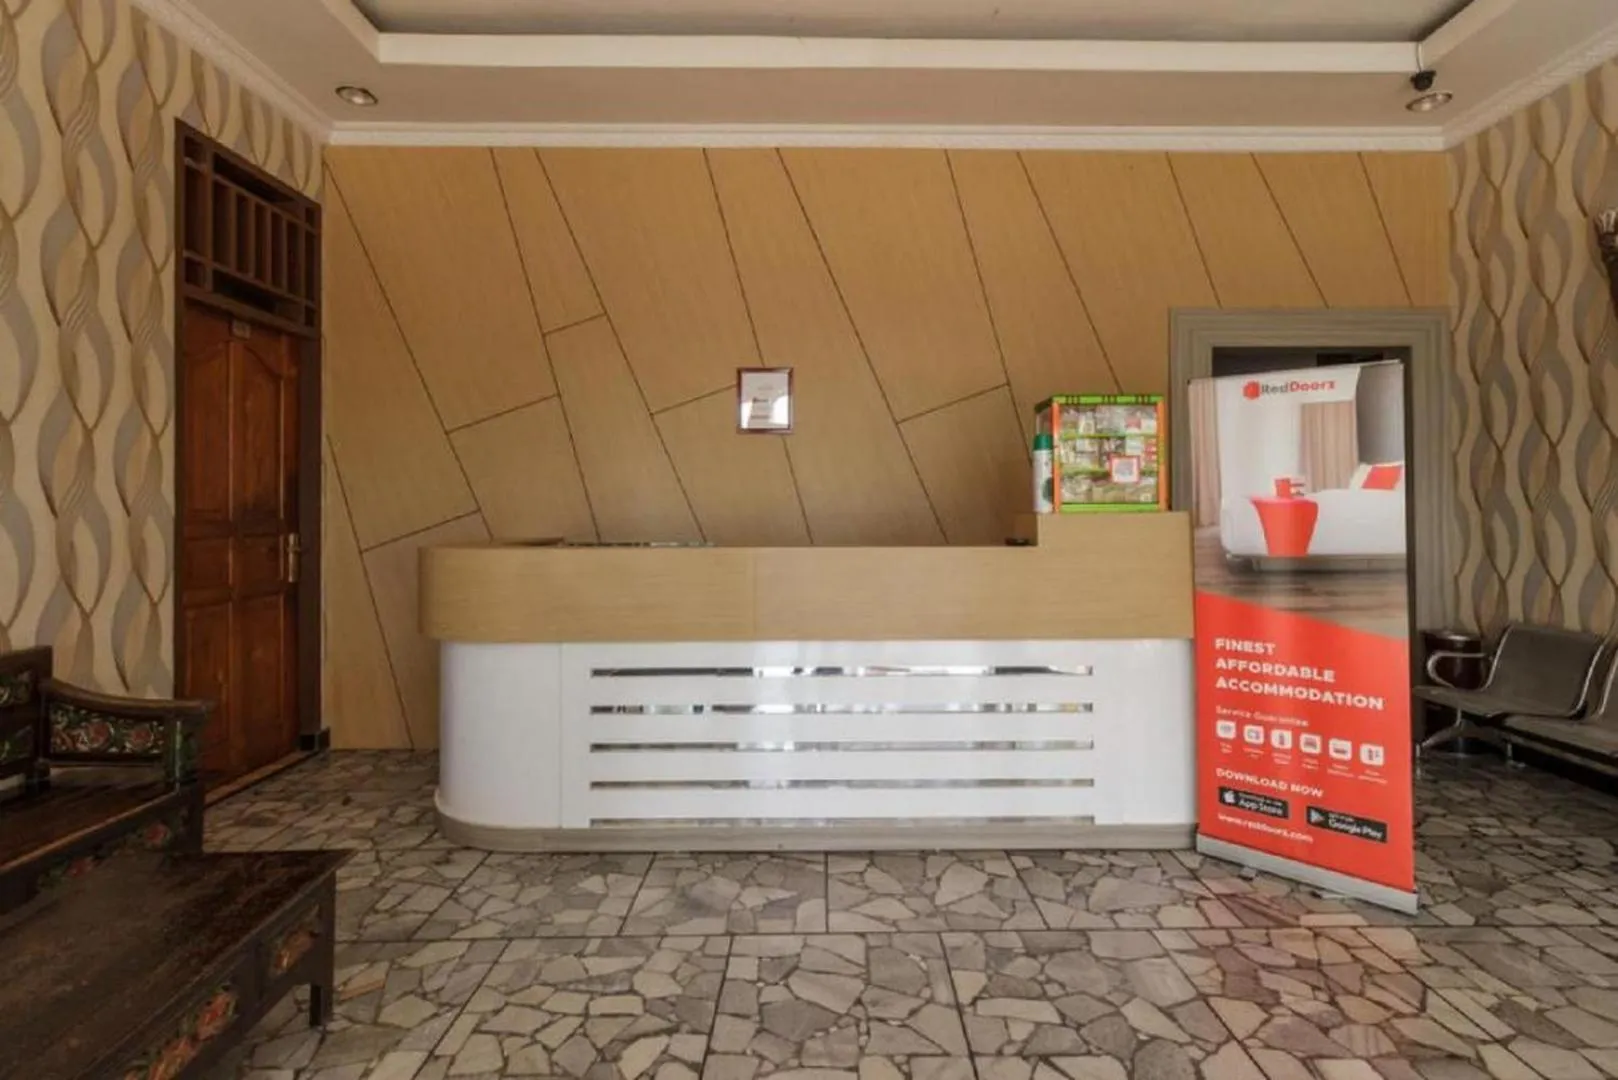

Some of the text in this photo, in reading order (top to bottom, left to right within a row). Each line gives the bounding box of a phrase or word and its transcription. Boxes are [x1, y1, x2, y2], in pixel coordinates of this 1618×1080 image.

[1214, 637, 1276, 655] FINEST
[1215, 657, 1336, 683] AFFORDABLE
[1215, 676, 1384, 710] ACCOMMODATION
[1215, 705, 1252, 718] Service
[1215, 767, 1325, 797] DOWNLOAD NOW
[1238, 799, 1258, 810] App
[1259, 803, 1284, 815] Store
[1328, 819, 1384, 840] Google Play
